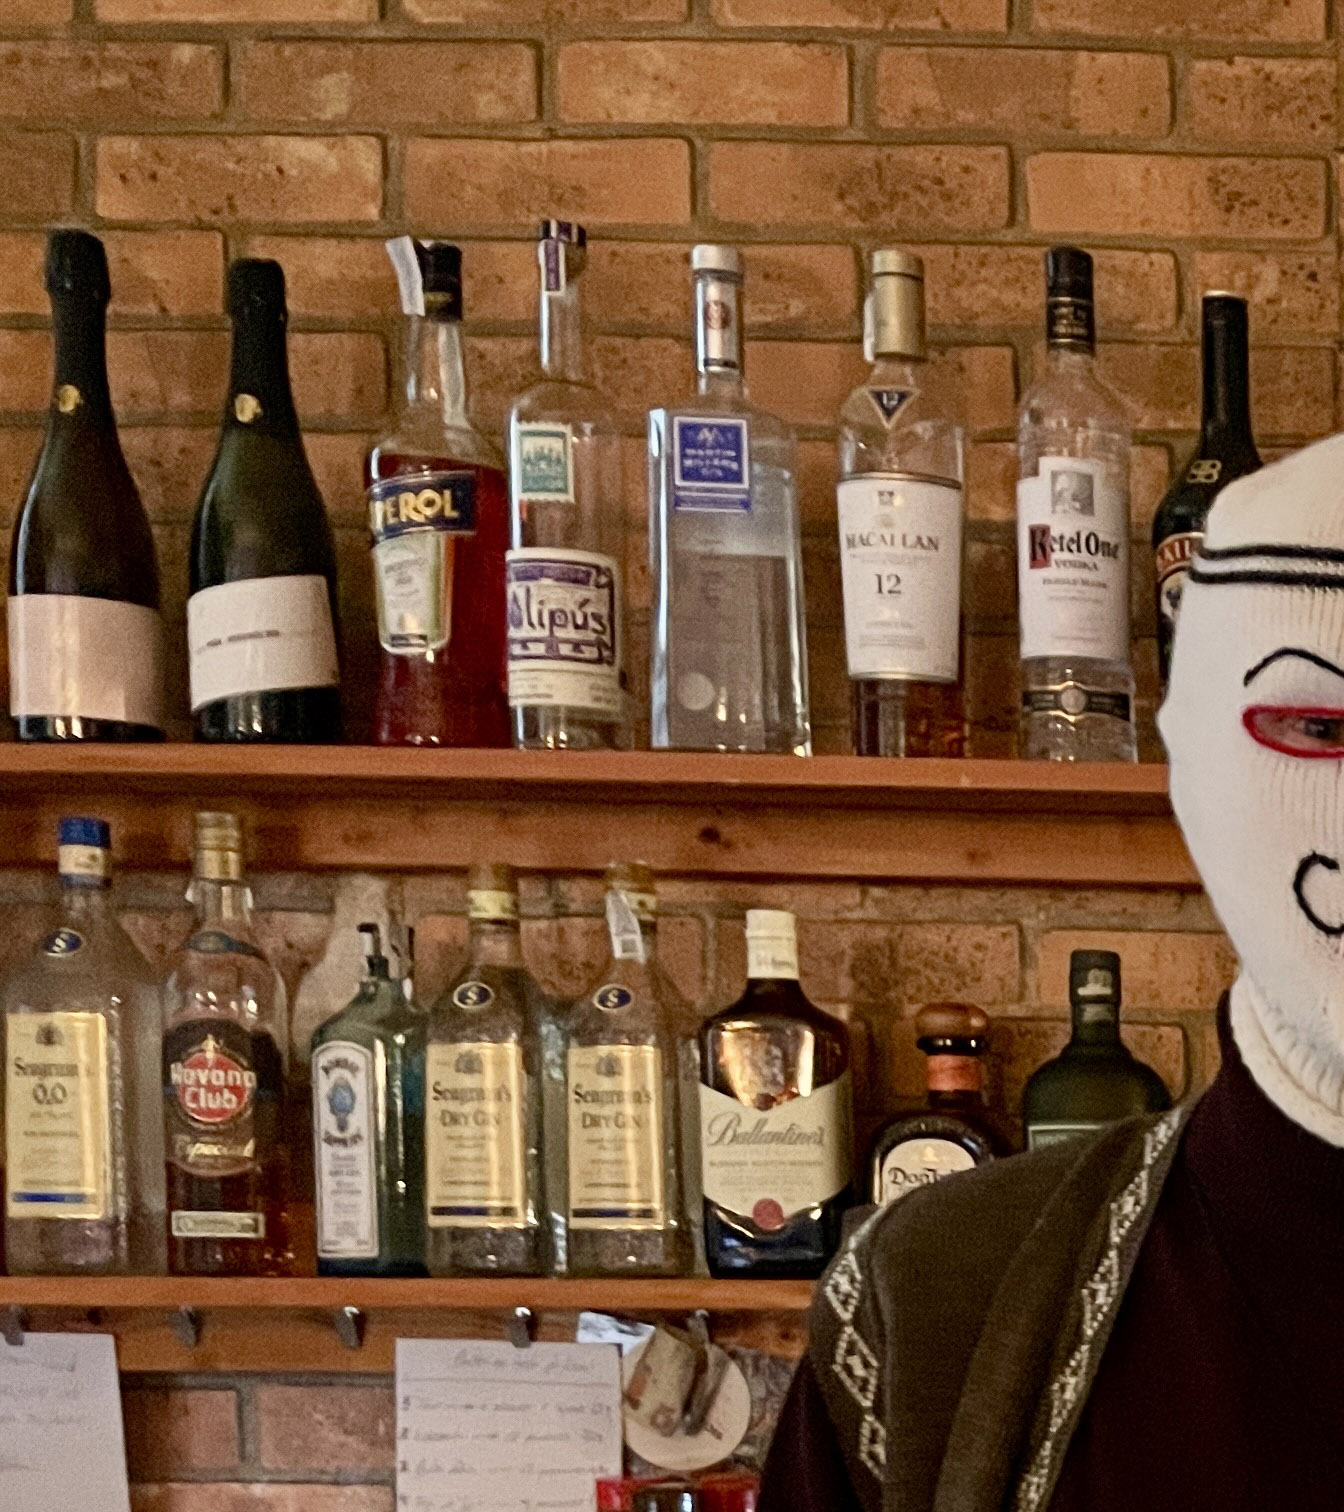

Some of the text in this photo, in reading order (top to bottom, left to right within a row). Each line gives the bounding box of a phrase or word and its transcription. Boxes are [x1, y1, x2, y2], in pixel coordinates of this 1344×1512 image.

[845, 532, 938, 551] MACALLAN
[1029, 527, 1119, 564] Ketel One
[875, 573, 902, 594] 12
[171, 1062, 258, 1087] Havana
[184, 1086, 237, 1110] Club
[708, 1112, 826, 1147] Ballantine's
